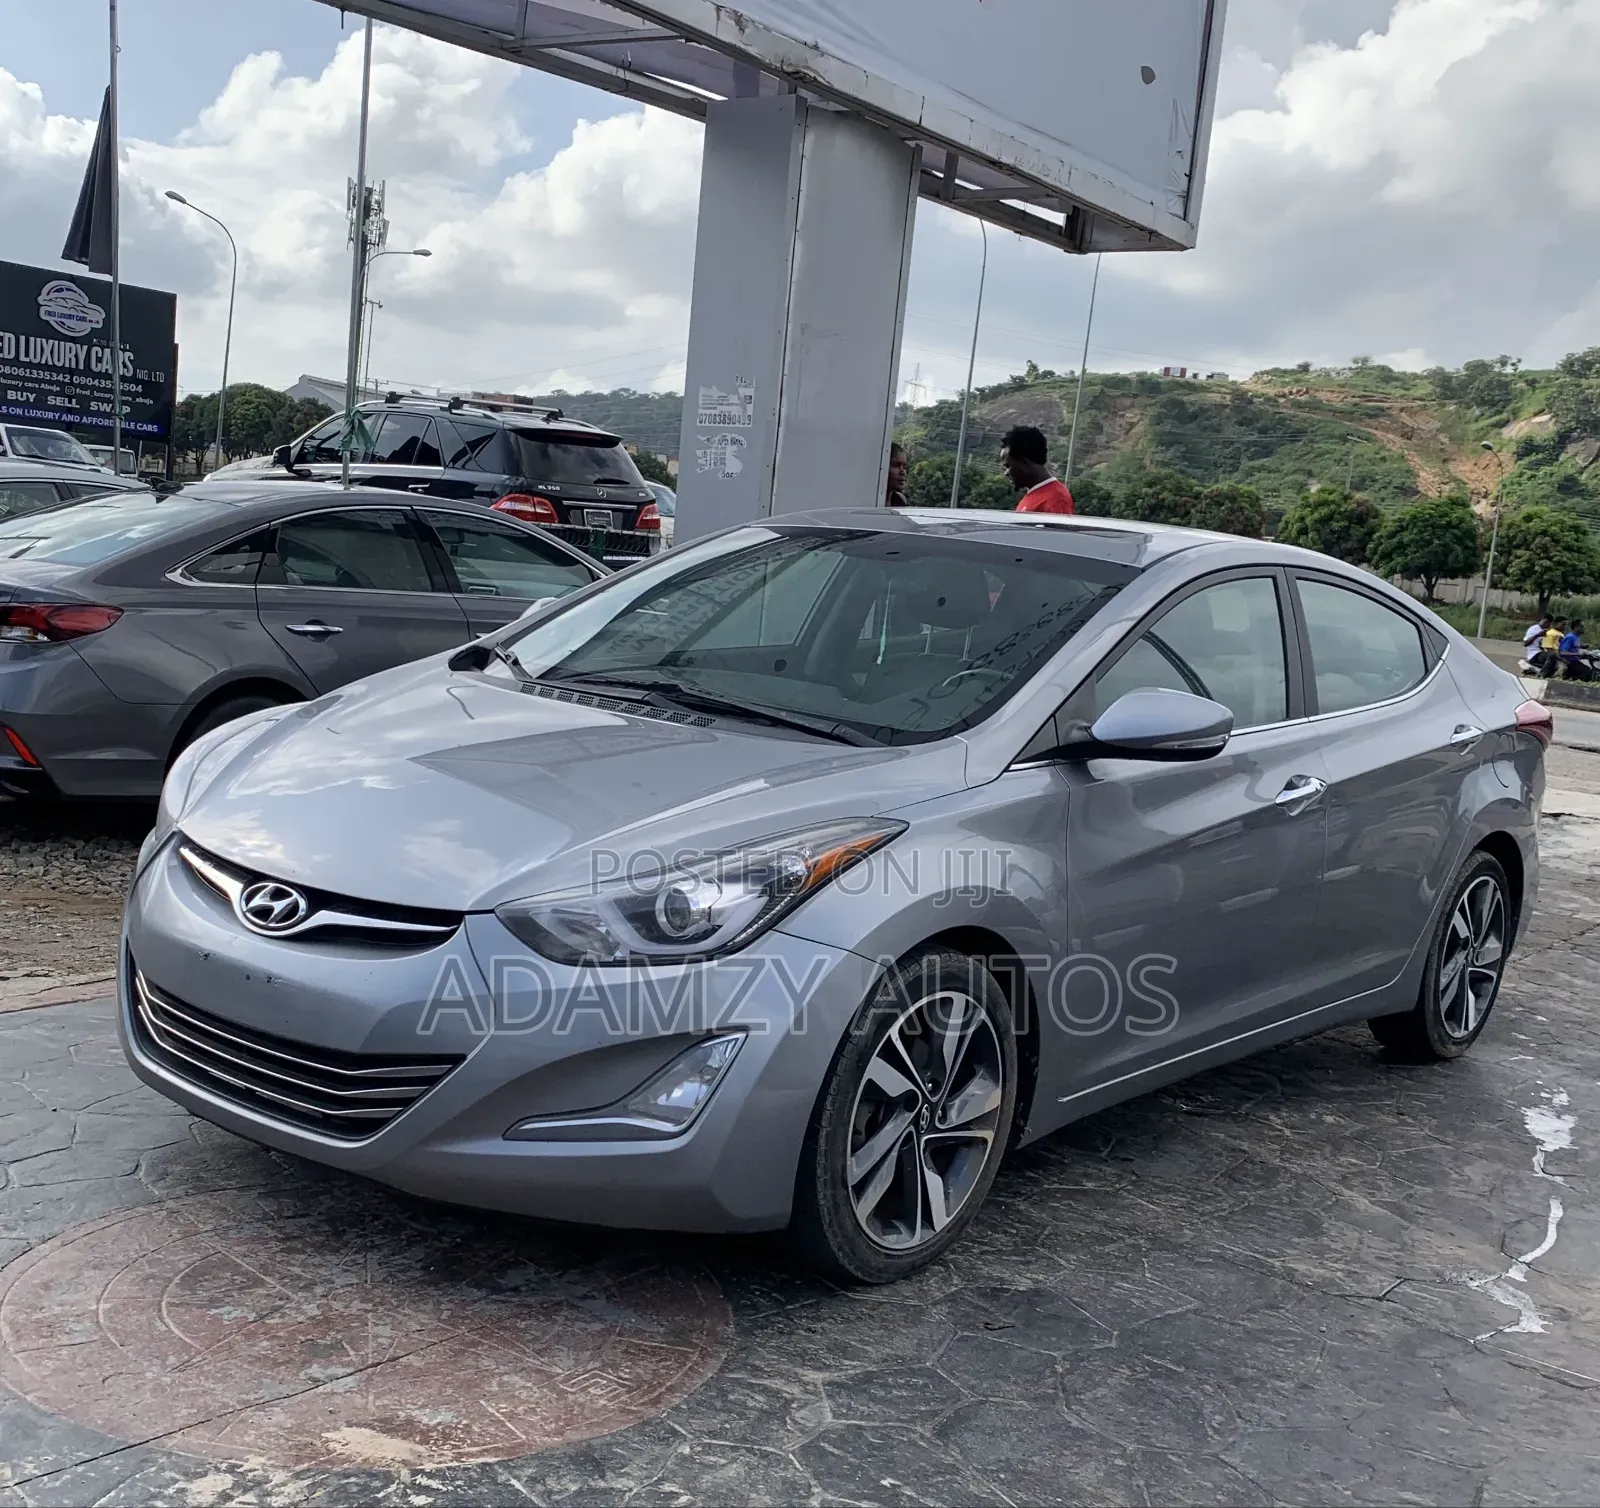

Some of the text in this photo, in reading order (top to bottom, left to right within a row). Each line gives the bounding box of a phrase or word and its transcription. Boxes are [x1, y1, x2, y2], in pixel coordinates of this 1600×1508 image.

[19, 334, 88, 370] LUXURY
[90, 345, 134, 377] CARS
[151, 371, 165, 383] LTD
[0, 364, 71, 383] 08061335342
[40, 383, 60, 392] Abuja
[7, 389, 131, 414] BUY SELL SWP
[0, 405, 158, 432] S ON LUXURY AND AFFORDBLE CARS
